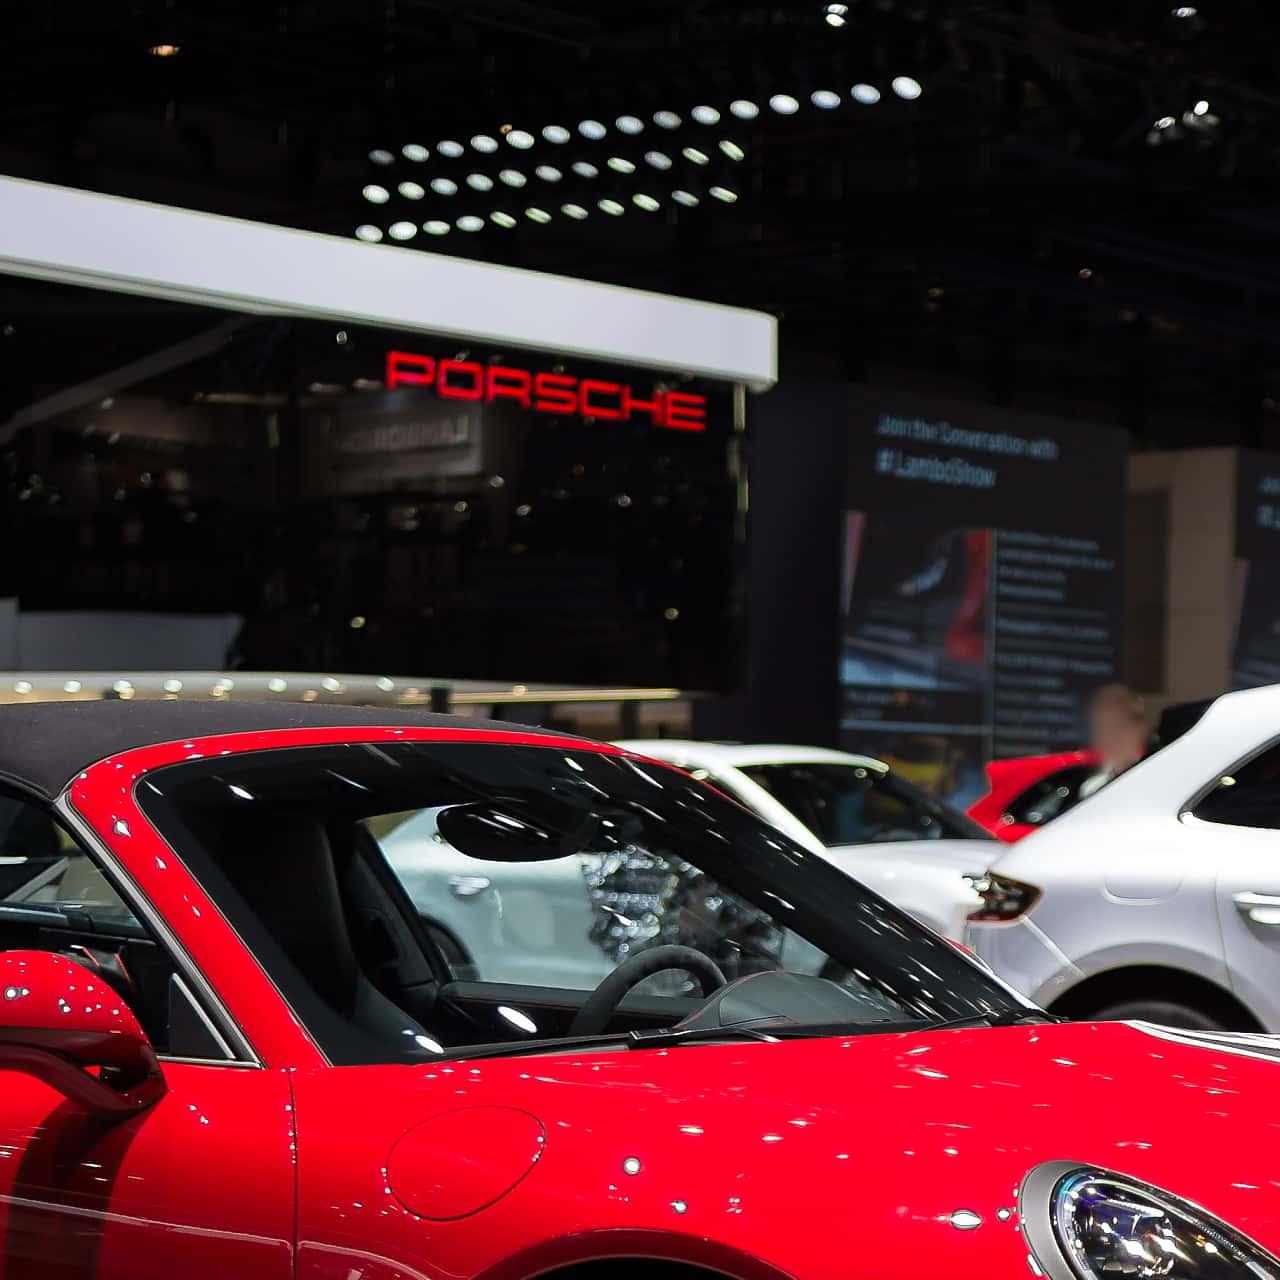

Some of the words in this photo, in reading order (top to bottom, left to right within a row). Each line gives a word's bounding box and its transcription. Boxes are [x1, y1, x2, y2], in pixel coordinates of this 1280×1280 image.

[385, 350, 708, 433] PORSCHE
[878, 414, 911, 439] Join
[912, 418, 938, 443] the
[940, 420, 1028, 457] Conversation
[1029, 437, 1059, 461] with
